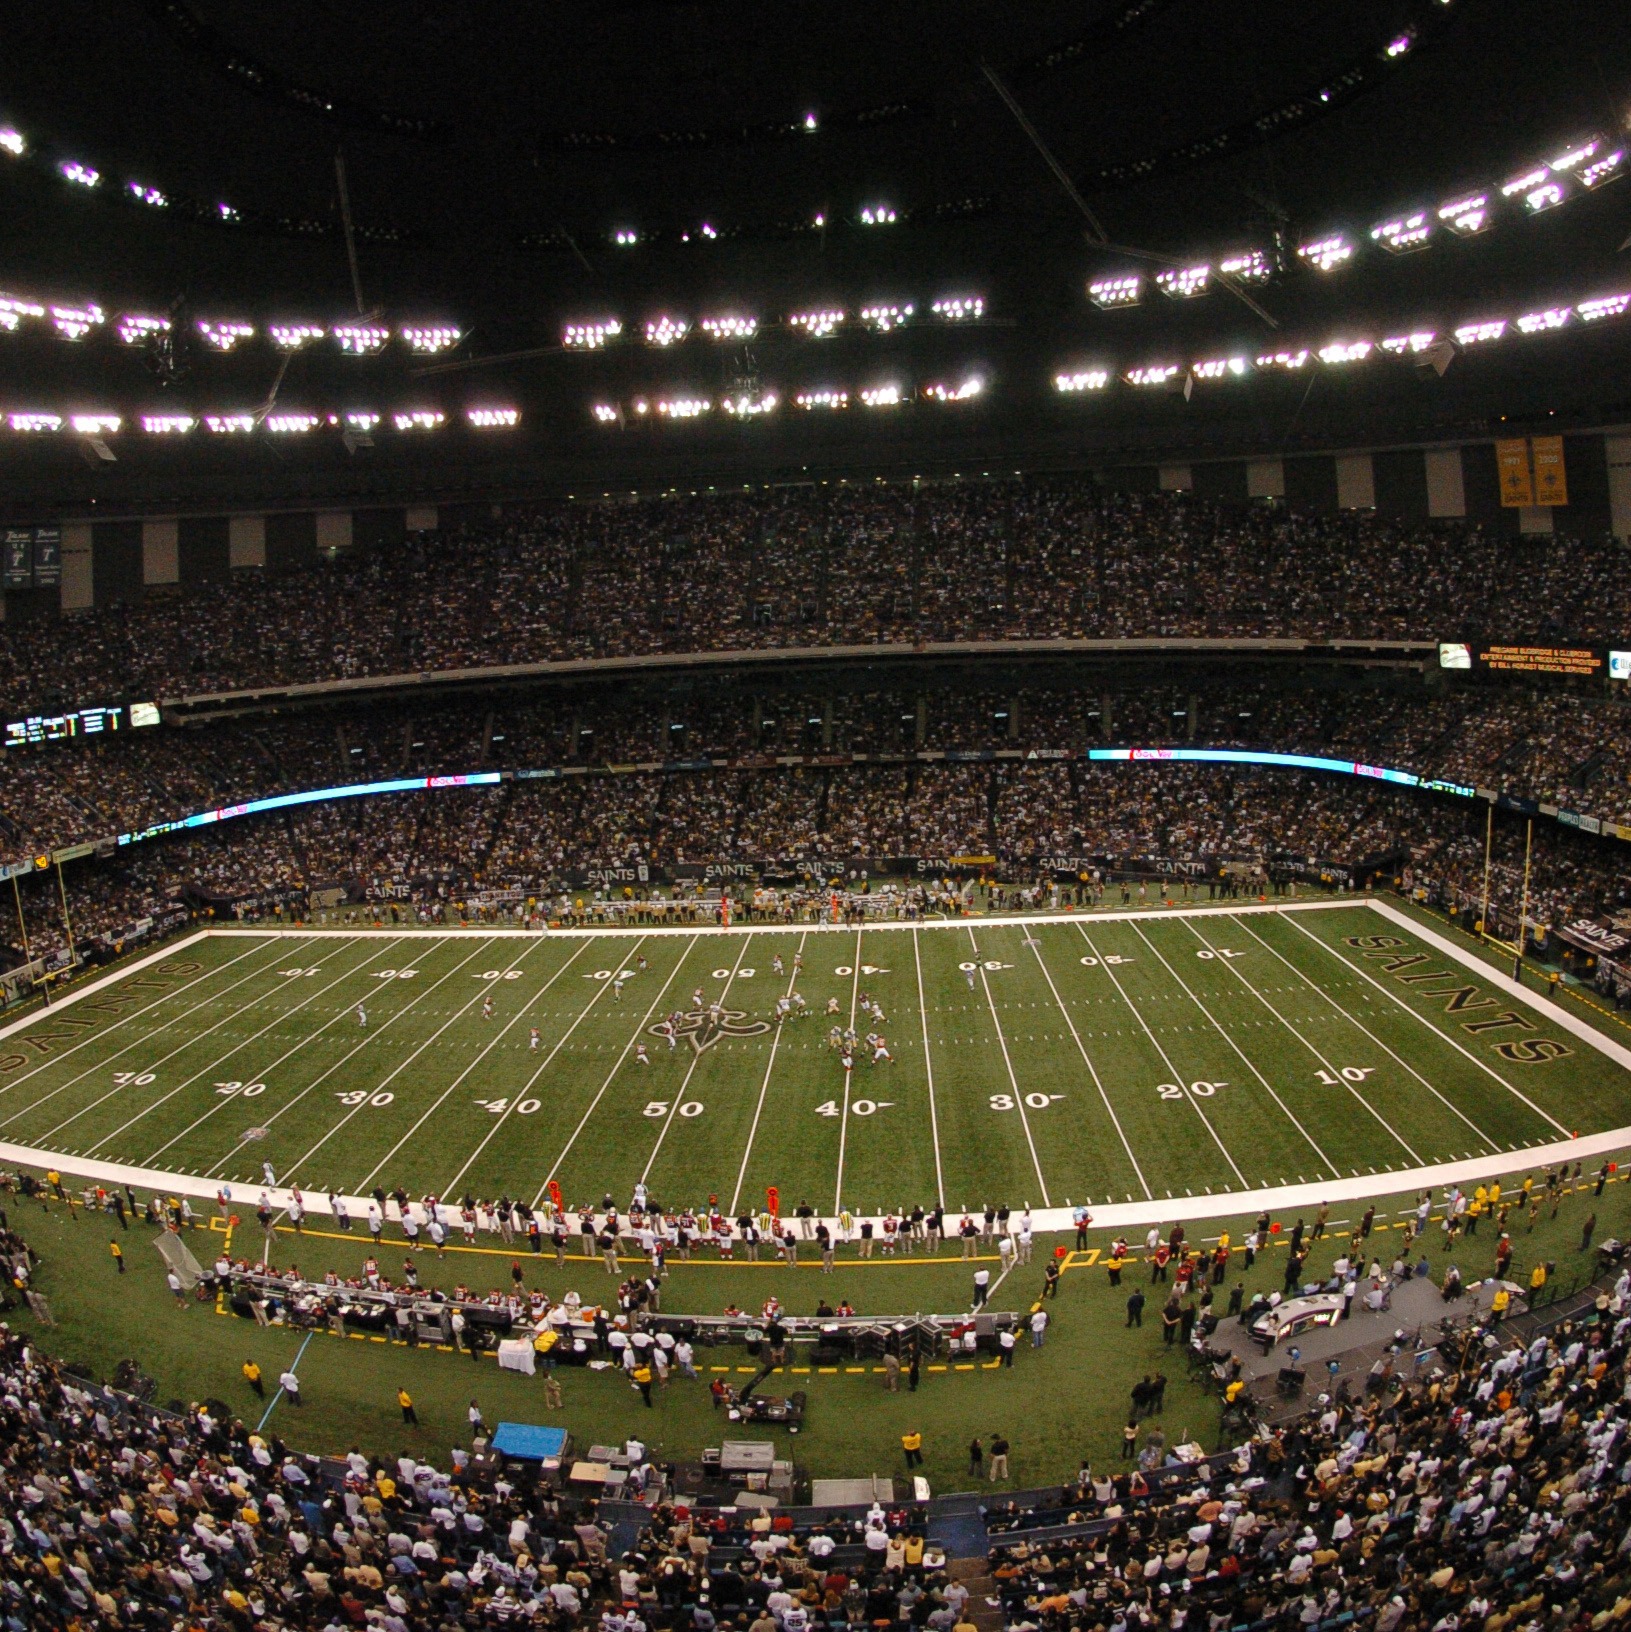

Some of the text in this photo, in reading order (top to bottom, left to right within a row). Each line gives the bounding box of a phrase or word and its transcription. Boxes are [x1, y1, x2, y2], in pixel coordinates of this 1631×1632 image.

[588, 868, 635, 882] SAINTS
[706, 864, 754, 877] SAINTS
[366, 885, 411, 899] SAINTS
[1571, 919, 1630, 946] SAINTS
[711, 967, 757, 980] 50
[1341, 935, 1575, 1064] SAINTS
[116, 1072, 157, 1086] 10
[1313, 1066, 1367, 1085] 10
[219, 1081, 267, 1097] 20
[1156, 1081, 1216, 1100] 20
[341, 1090, 395, 1108] 30
[484, 1098, 542, 1115] 40
[989, 1092, 1051, 1111] 30
[642, 1101, 704, 1118] 50
[814, 1100, 878, 1117] 40
